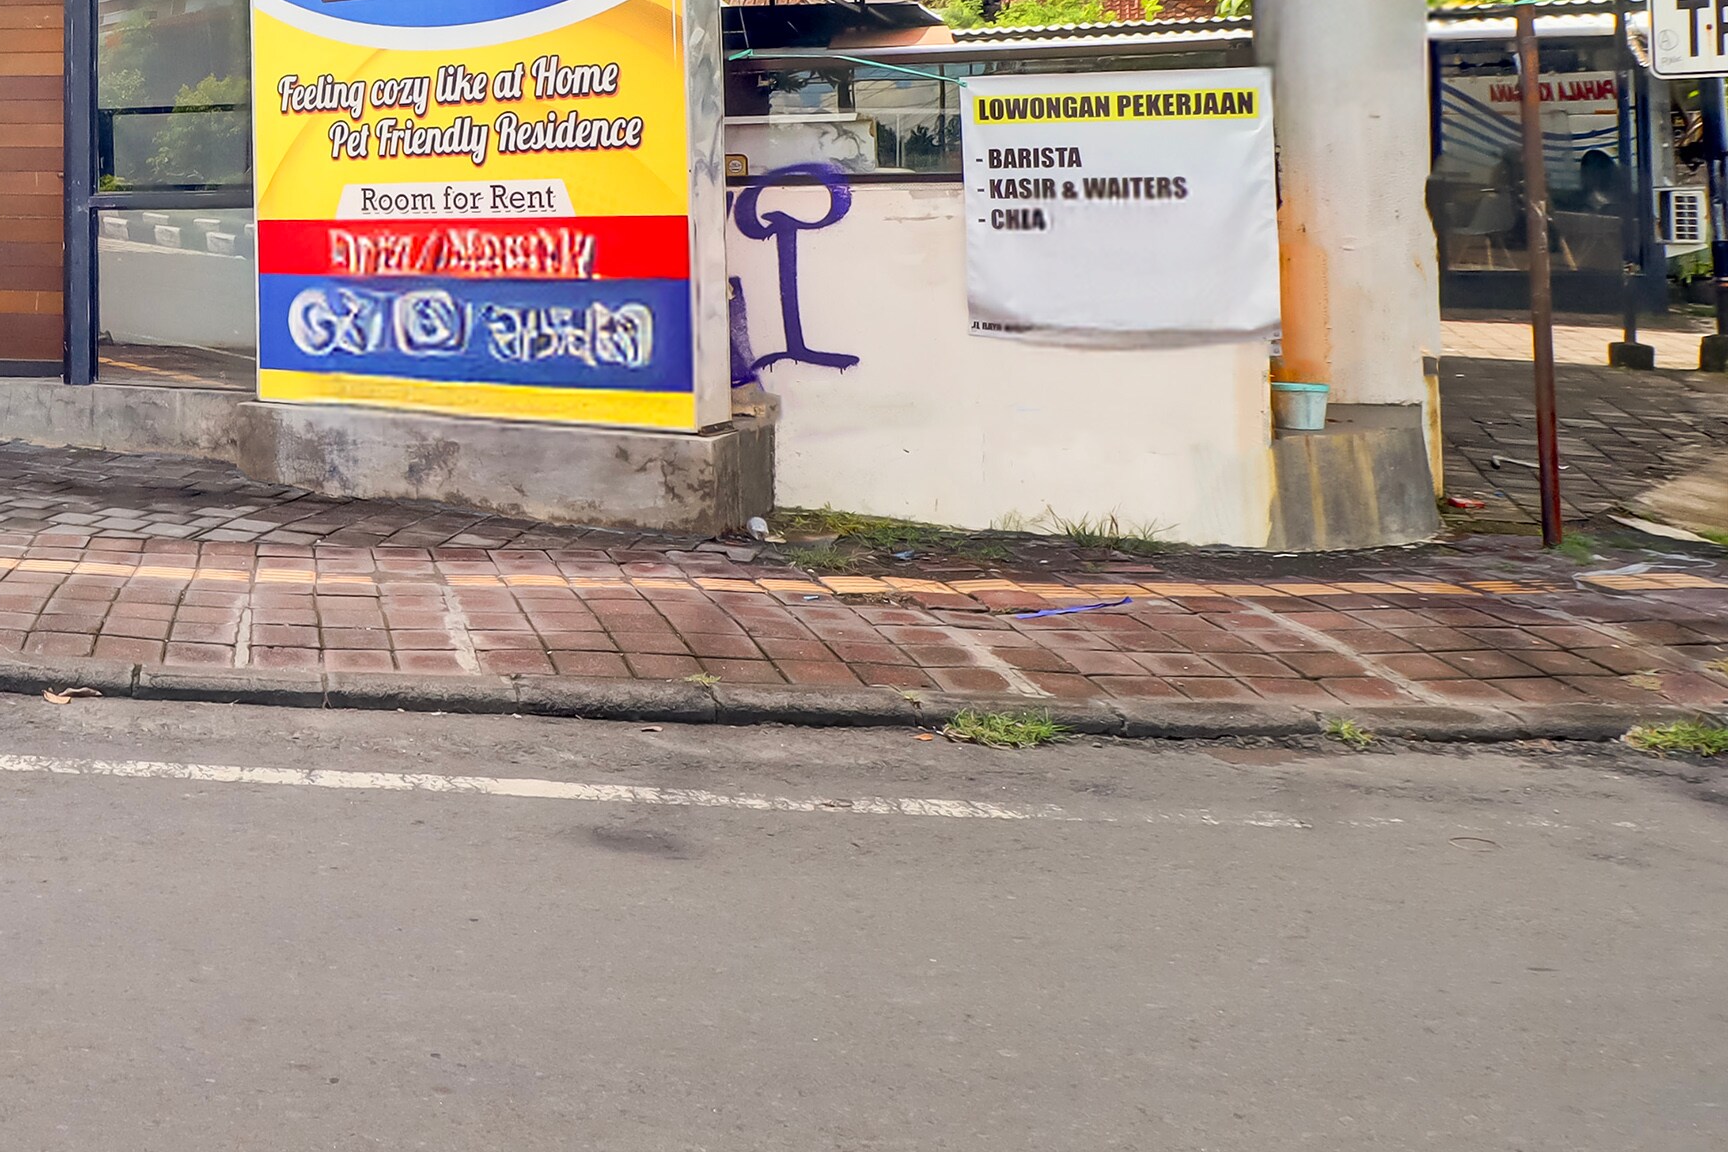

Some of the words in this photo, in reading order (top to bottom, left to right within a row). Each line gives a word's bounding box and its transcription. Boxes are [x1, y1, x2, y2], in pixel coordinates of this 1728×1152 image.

[277, 74, 367, 120] Feeling
[370, 77, 431, 116] cozy
[435, 64, 488, 104] like
[492, 62, 525, 101] at
[531, 55, 619, 99] Home
[978, 94, 1111, 122] LOWONGAN
[1116, 91, 1254, 118] PEKERJAAN
[328, 120, 371, 159] Pet
[376, 116, 489, 166] Friendly
[494, 110, 644, 152] Residence
[988, 146, 1083, 169] BARISTA
[361, 187, 436, 212] Room
[443, 185, 483, 211] for
[489, 184, 556, 210] Rent
[989, 178, 1057, 199] KASIR
[1062, 180, 1078, 200] &
[1082, 176, 1188, 199] WAITERS
